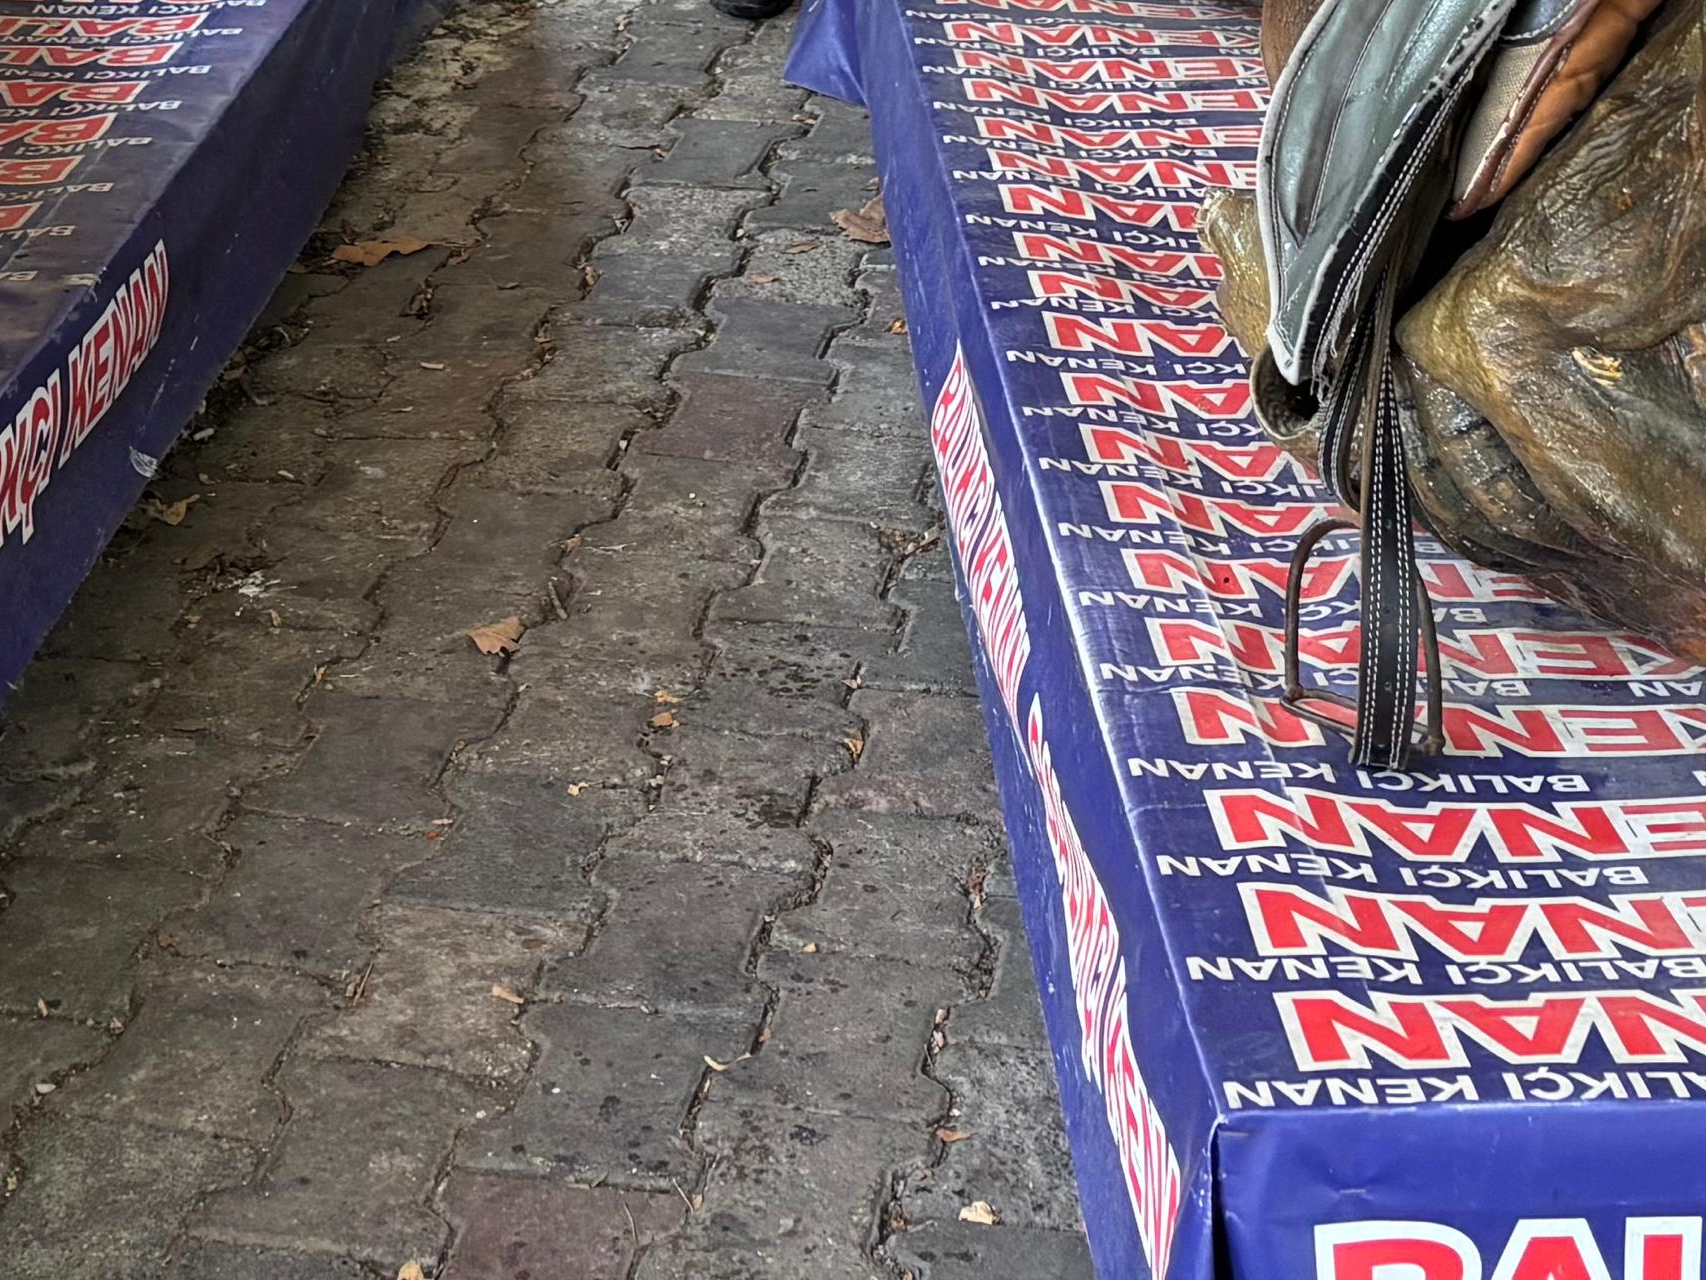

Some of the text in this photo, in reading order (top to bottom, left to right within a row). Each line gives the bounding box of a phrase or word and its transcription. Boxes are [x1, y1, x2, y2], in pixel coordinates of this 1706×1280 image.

[961, 77, 1269, 114] ENAN
[964, 213, 1099, 239] KENAN
[990, 299, 1136, 315] KENAN
[58, 238, 169, 469] KENAN
[1006, 350, 1156, 376] KENAN
[1022, 406, 1180, 433] KENAN
[1039, 457, 1202, 491] KENAN
[1059, 522, 1233, 556] KENAN
[1080, 590, 1263, 621] KENAN
[1127, 756, 1337, 786] KENAN
[1156, 852, 1650, 889] BALIKÇI KENAN
[1186, 955, 1423, 986] KENAN
[1221, 1073, 1481, 1110] KENAN
